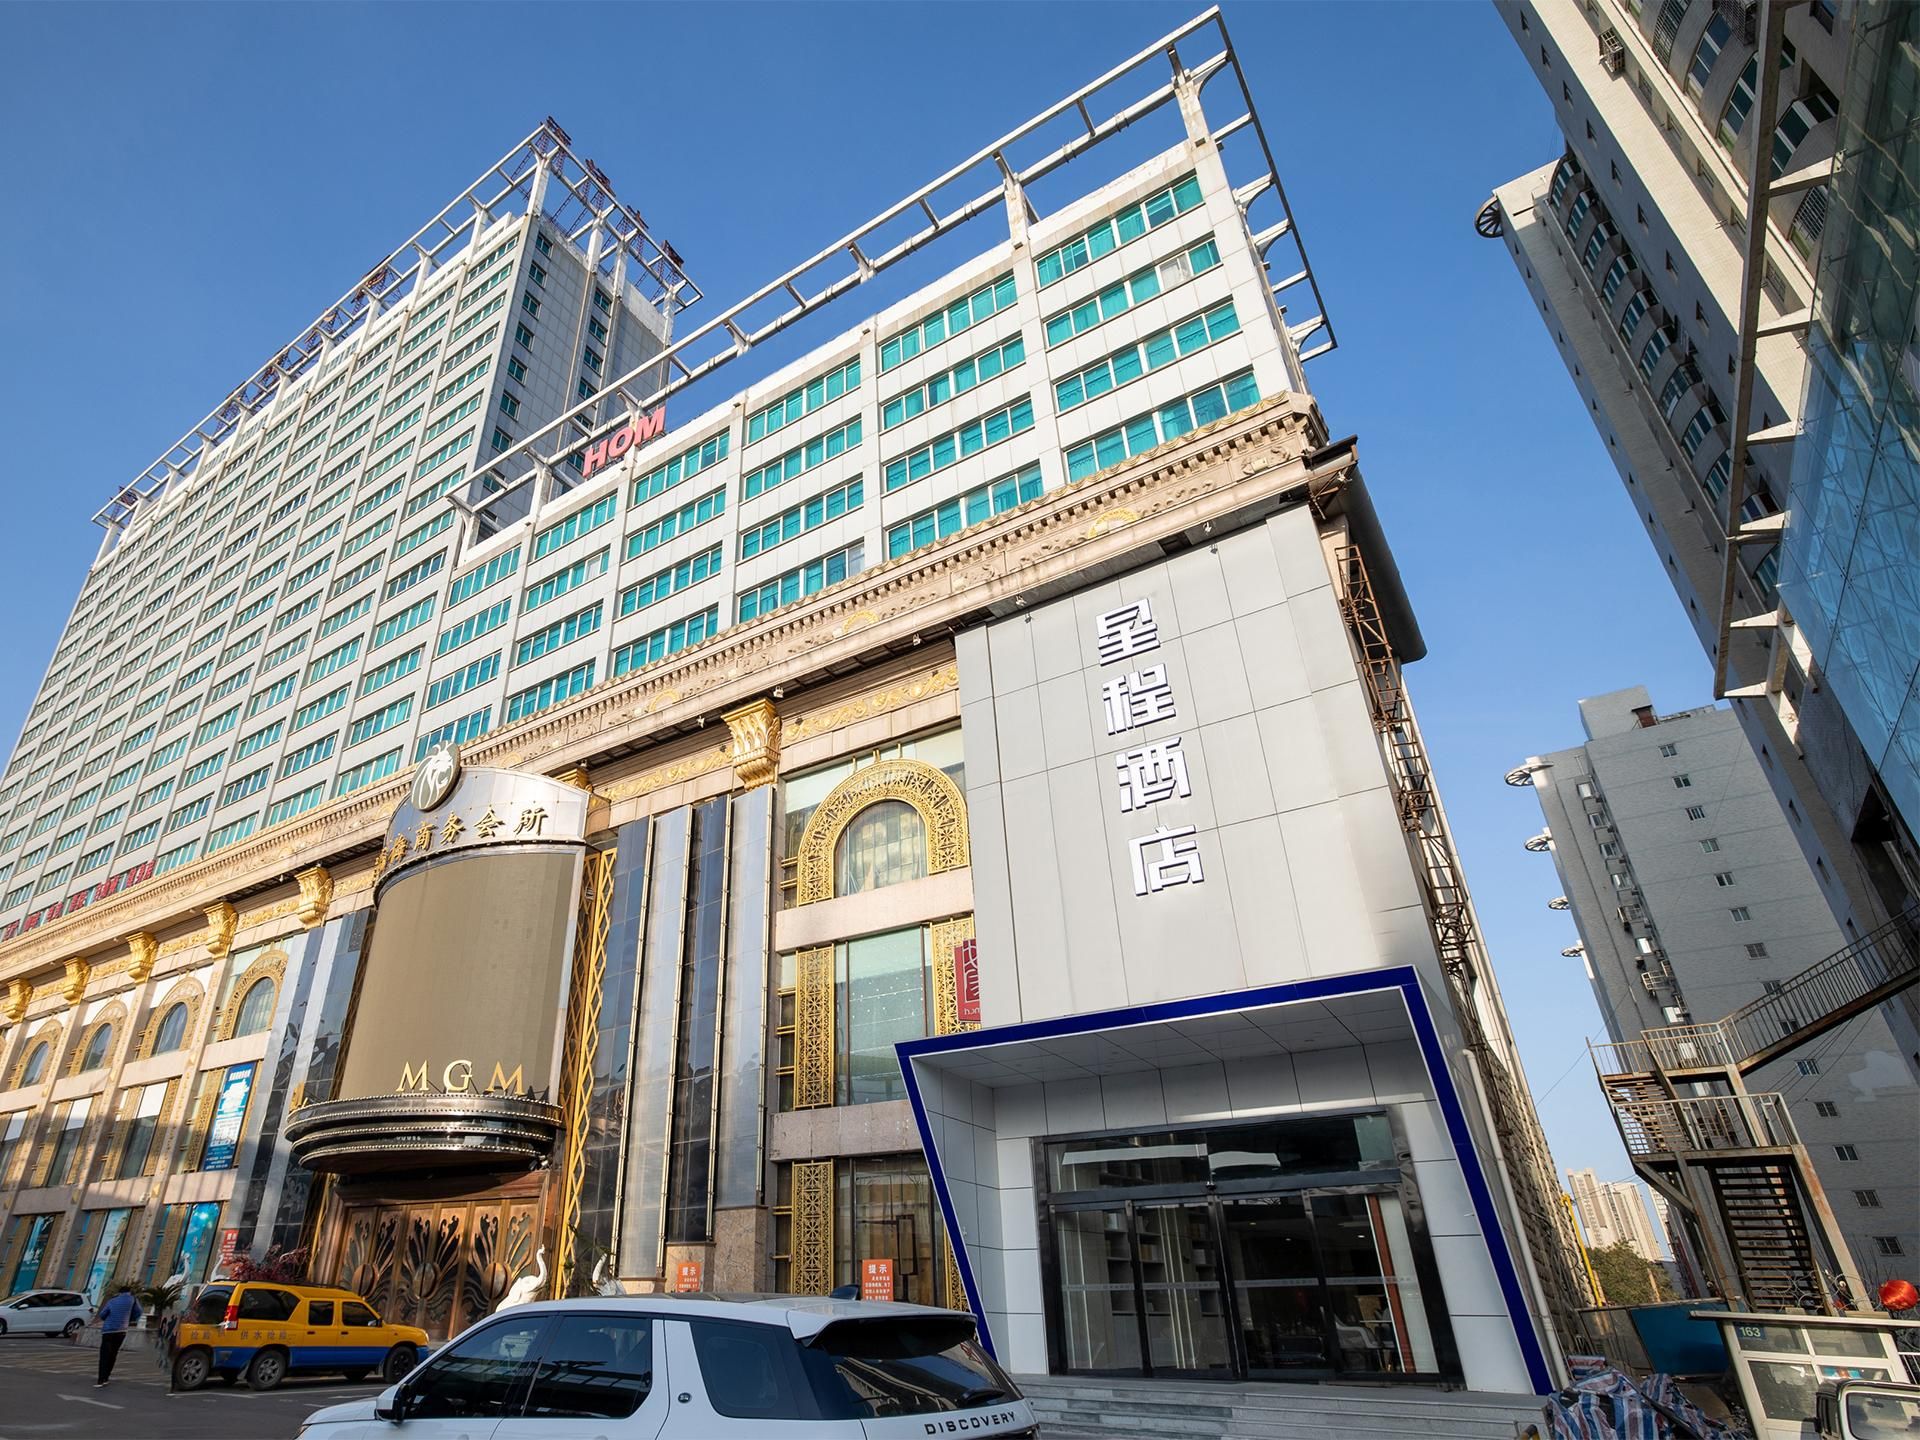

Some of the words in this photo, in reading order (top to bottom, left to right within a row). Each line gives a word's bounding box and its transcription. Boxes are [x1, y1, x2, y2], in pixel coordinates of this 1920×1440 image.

[582, 405, 666, 478] HOM
[1096, 598, 1204, 896] 星程酒店
[396, 1059, 525, 1096] MGM
[1739, 1326, 1761, 1338] 163
[924, 1411, 1016, 1435] DISCOVERY
